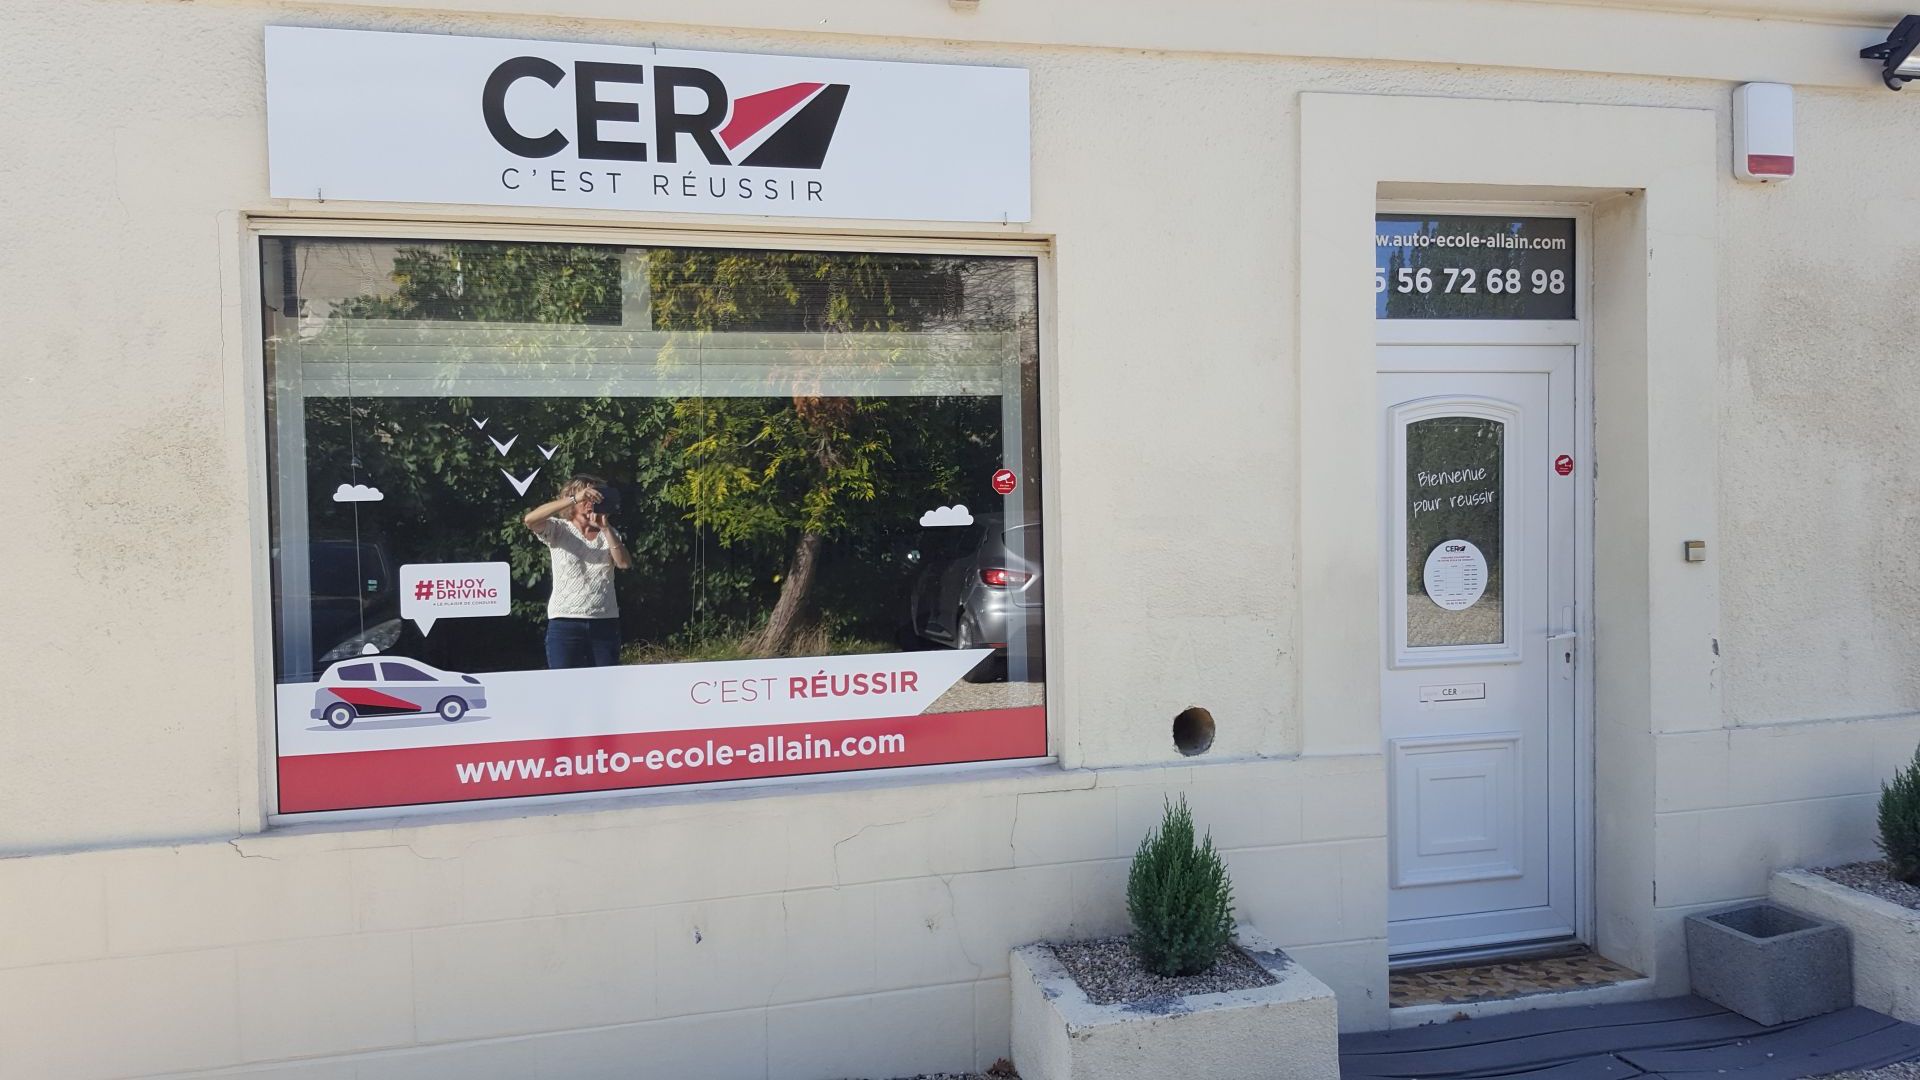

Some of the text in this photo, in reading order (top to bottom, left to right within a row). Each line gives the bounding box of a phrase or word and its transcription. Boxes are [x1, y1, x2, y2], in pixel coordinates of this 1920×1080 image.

[482, 55, 733, 166] CER
[501, 168, 824, 202] C'EST RÉUSSIR
[1397, 267, 1433, 294] 56
[1443, 267, 1477, 294] 72
[1486, 268, 1522, 294] 68
[1531, 269, 1566, 295] 98
[1417, 467, 1487, 487] Bienvenue
[1413, 487, 1495, 519] pour reussir
[436, 588, 498, 600] DRIVING
[690, 669, 919, 705] C'EST RÉUSSIR
[455, 730, 906, 785] www.auto-ecole-allain.com
